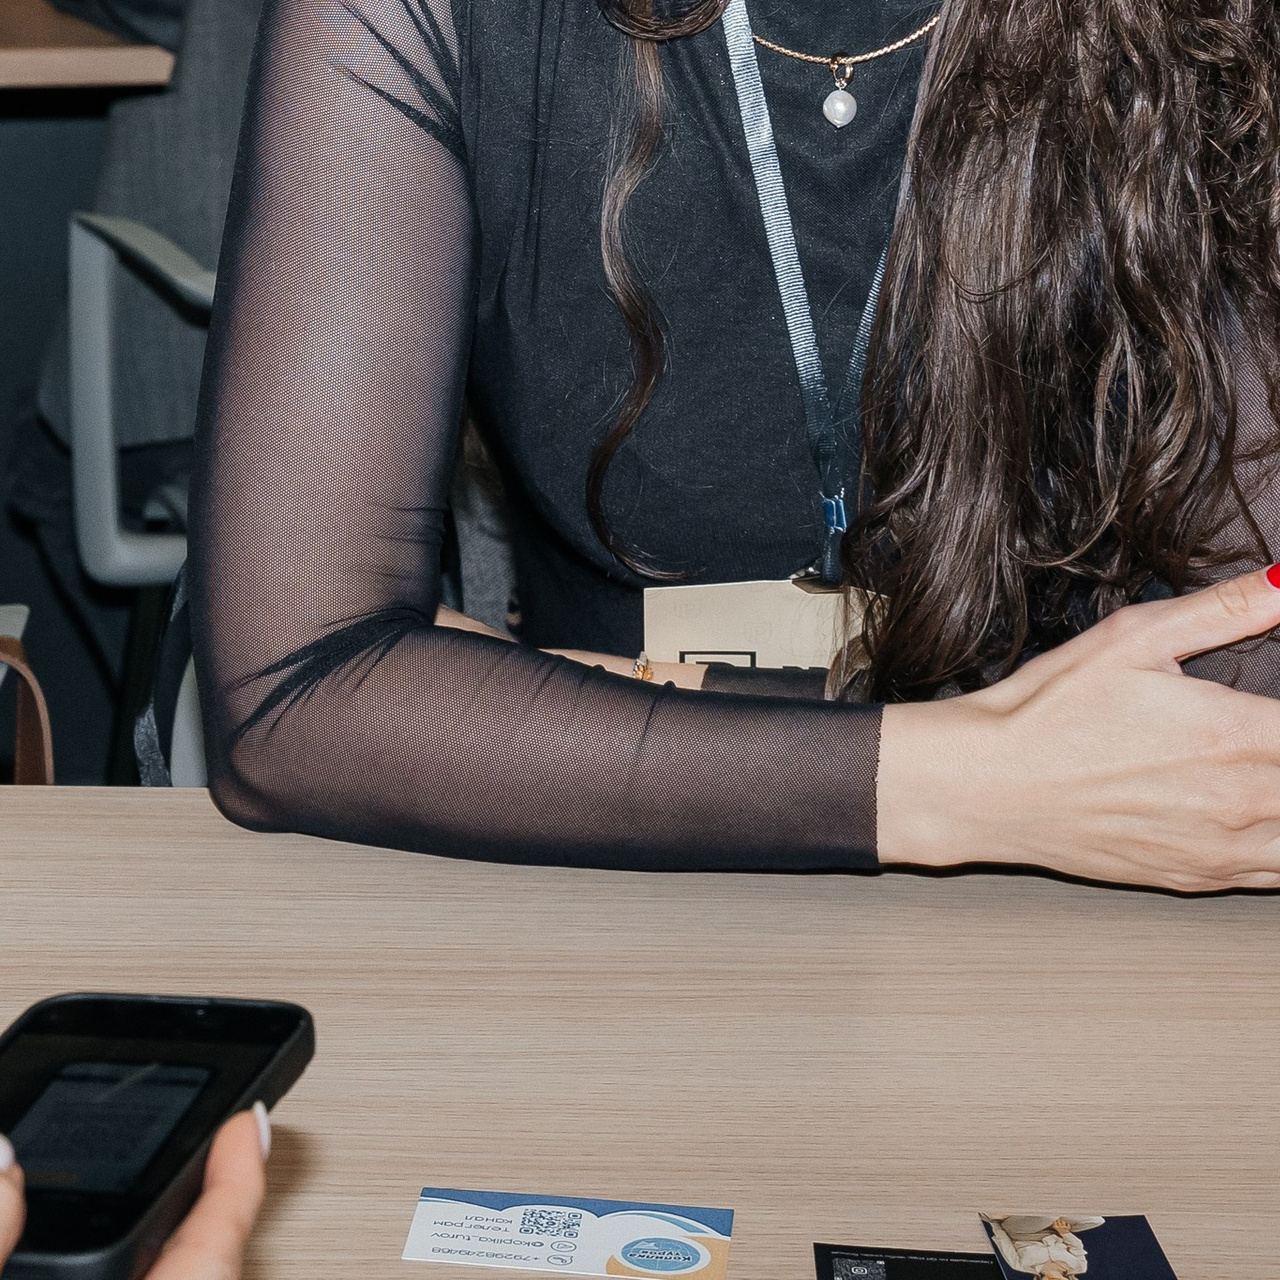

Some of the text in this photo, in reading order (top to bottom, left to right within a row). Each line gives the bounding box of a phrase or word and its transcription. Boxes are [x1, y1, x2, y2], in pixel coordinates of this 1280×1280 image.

[465, 1215, 513, 1224] канал
[433, 1220, 510, 1233] телеграм
[430, 1232, 545, 1247] @kopilka_turov
